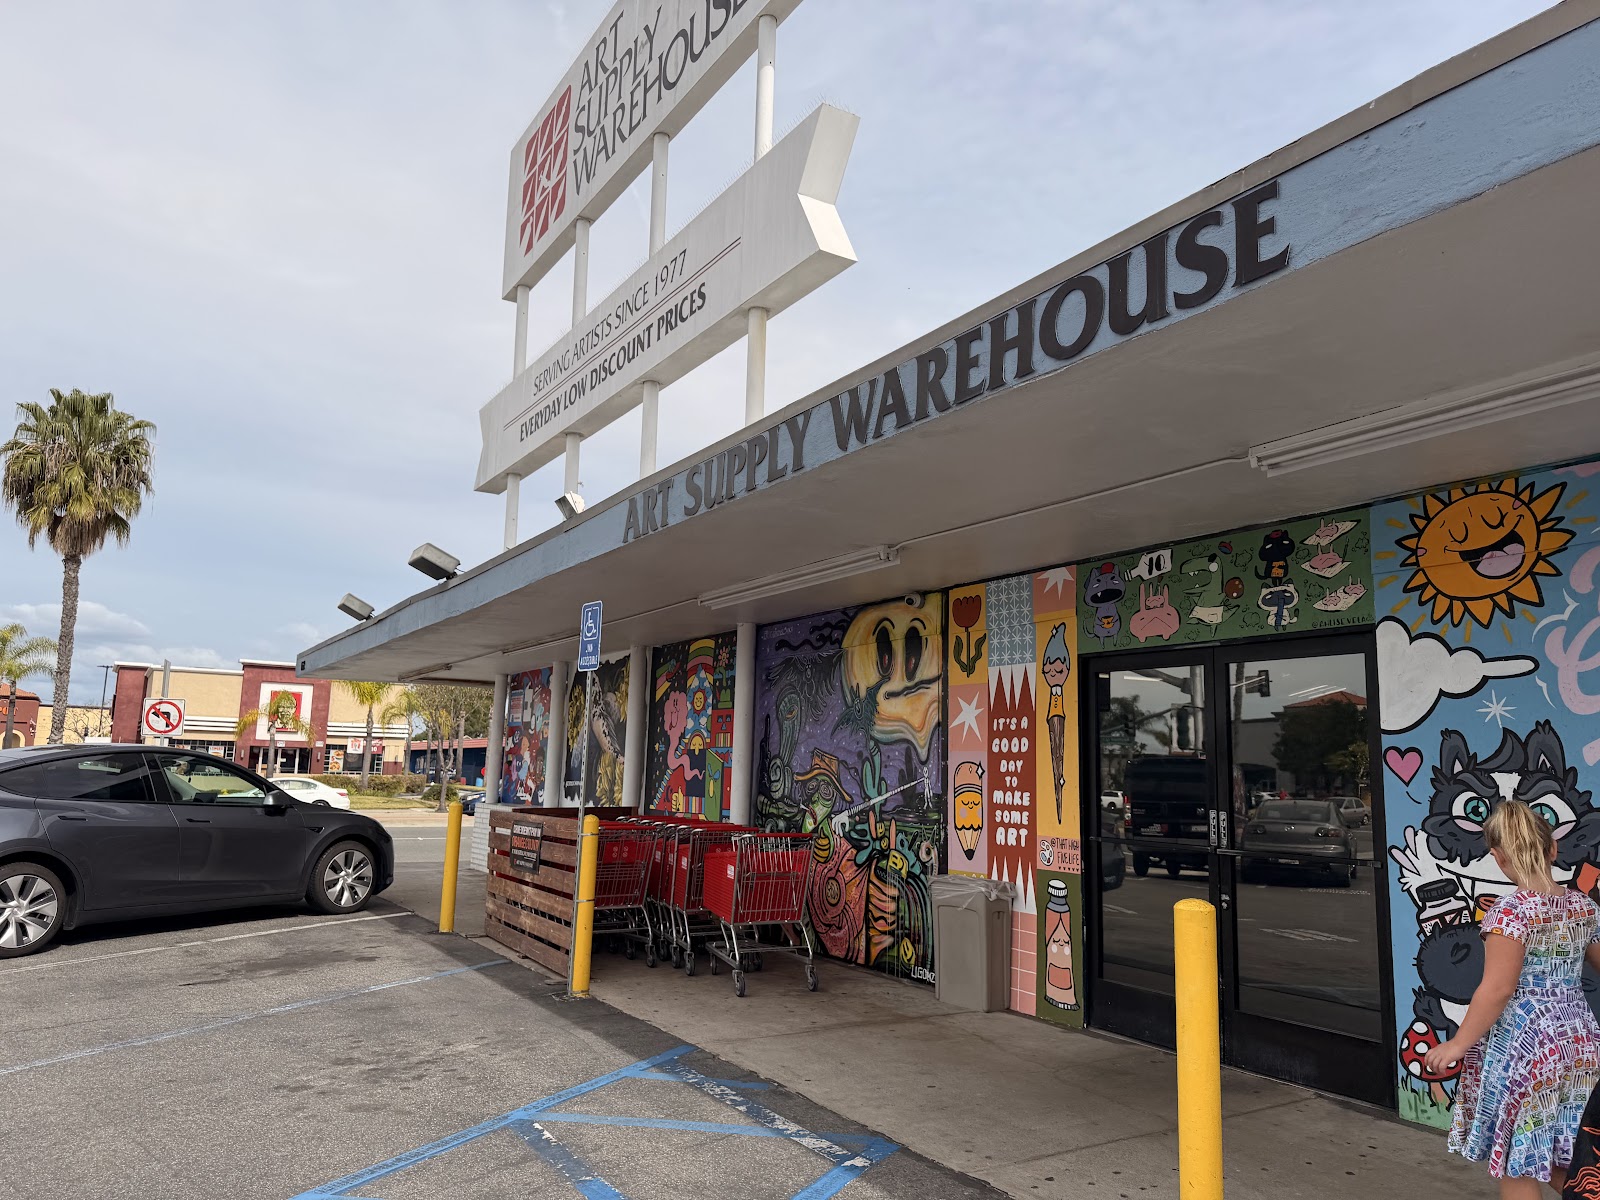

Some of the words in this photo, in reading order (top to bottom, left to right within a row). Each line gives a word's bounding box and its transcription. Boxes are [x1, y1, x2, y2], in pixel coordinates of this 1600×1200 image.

[576, 9, 624, 112] ART
[573, 4, 662, 156] SUPPLY
[573, 0, 748, 196] WAREHOUS
[533, 350, 570, 396] SERVING
[571, 313, 612, 366] ARTISTS
[614, 281, 649, 330] SINCE
[654, 248, 687, 296] 1977
[520, 394, 562, 443] EVERYDAY
[563, 374, 588, 411] LOW
[590, 323, 654, 392] DISCOUNT
[656, 282, 707, 342] PRICES
[622, 477, 674, 543] ART
[683, 408, 813, 516] SUPPLY
[830, 180, 1291, 451] WAREHOUSE
[993, 717, 1018, 731] IT'S
[1020, 716, 1029, 730] A
[991, 737, 1029, 753] GOOD
[1000, 759, 1023, 773] DAY
[1005, 776, 1018, 788] TO
[992, 790, 1031, 806] MAKE
[995, 810, 1030, 825] SOME
[995, 827, 1029, 847] ART
